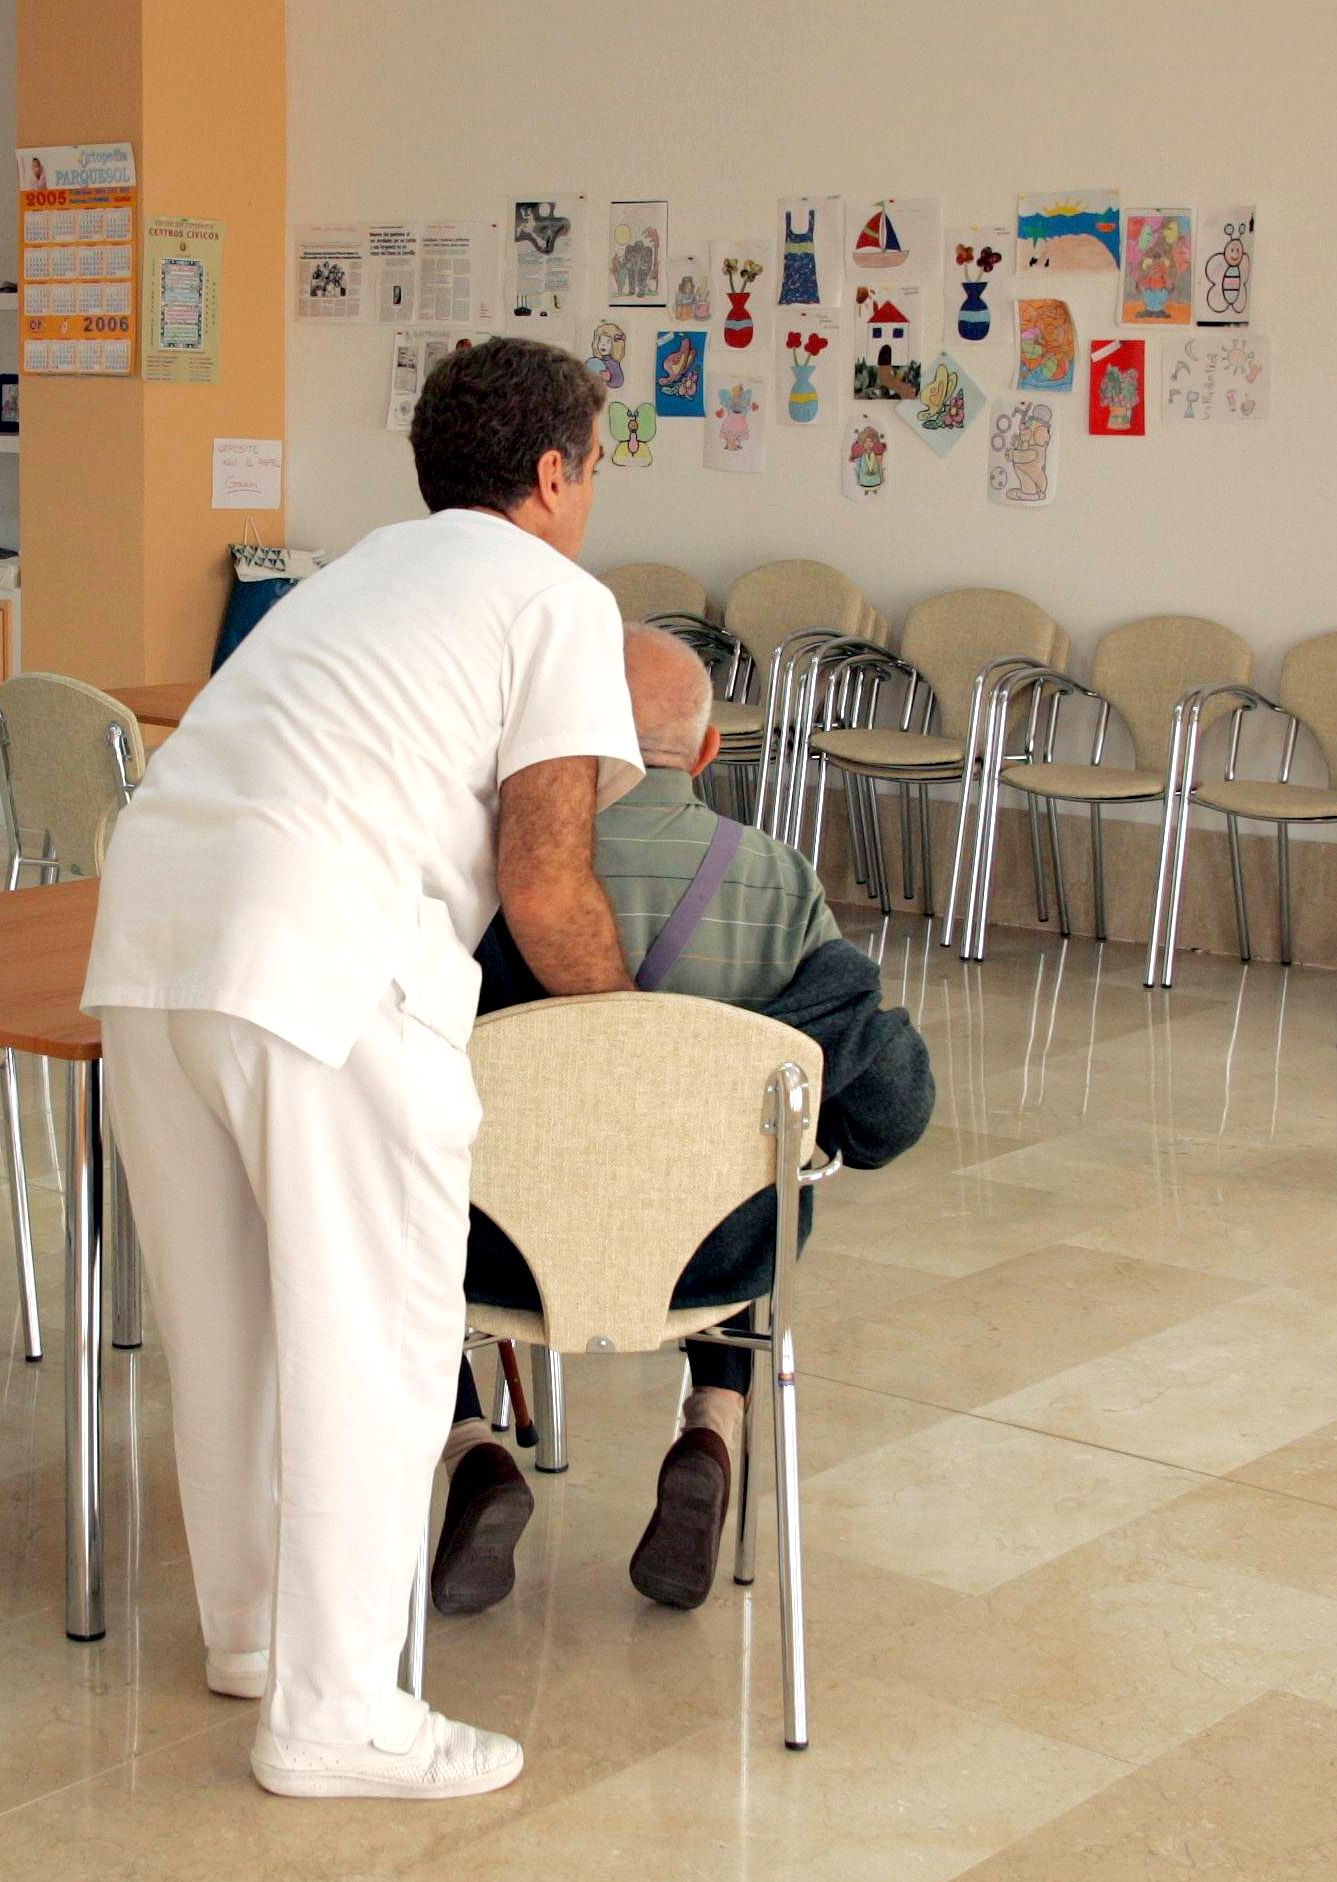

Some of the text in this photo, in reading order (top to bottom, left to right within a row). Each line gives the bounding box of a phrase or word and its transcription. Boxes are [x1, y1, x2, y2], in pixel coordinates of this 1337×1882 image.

[25, 191, 67, 206] 2005
[148, 227, 184, 239] CENTROS
[84, 316, 129, 332] 2006
